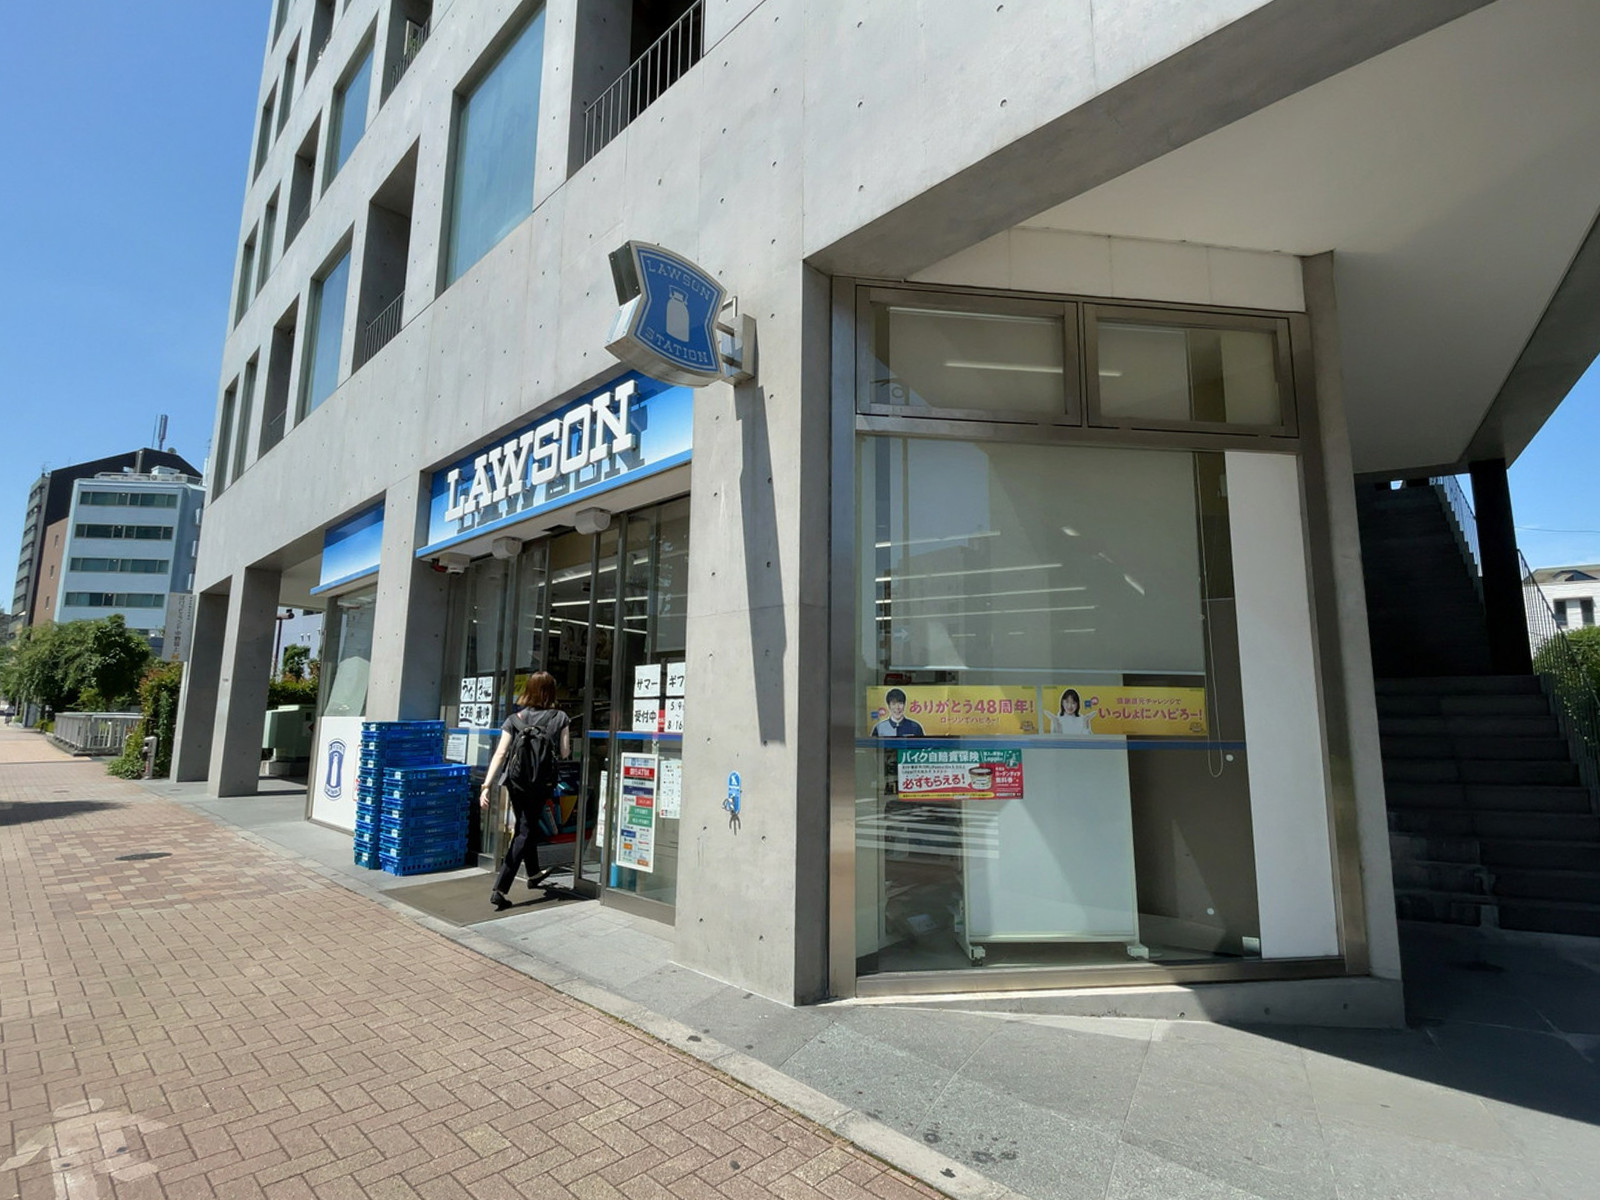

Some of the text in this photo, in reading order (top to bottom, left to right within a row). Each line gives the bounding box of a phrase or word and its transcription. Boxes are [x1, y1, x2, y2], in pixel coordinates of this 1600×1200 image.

[646, 260, 712, 301] LAWSON
[644, 325, 709, 363] STATION
[444, 379, 638, 523] LAWSON
[636, 678, 659, 691] サマー
[909, 698, 1035, 714] ありがとう48周年!
[634, 710, 657, 724] 受付中
[902, 774, 966, 790] 必ずもらえる!
